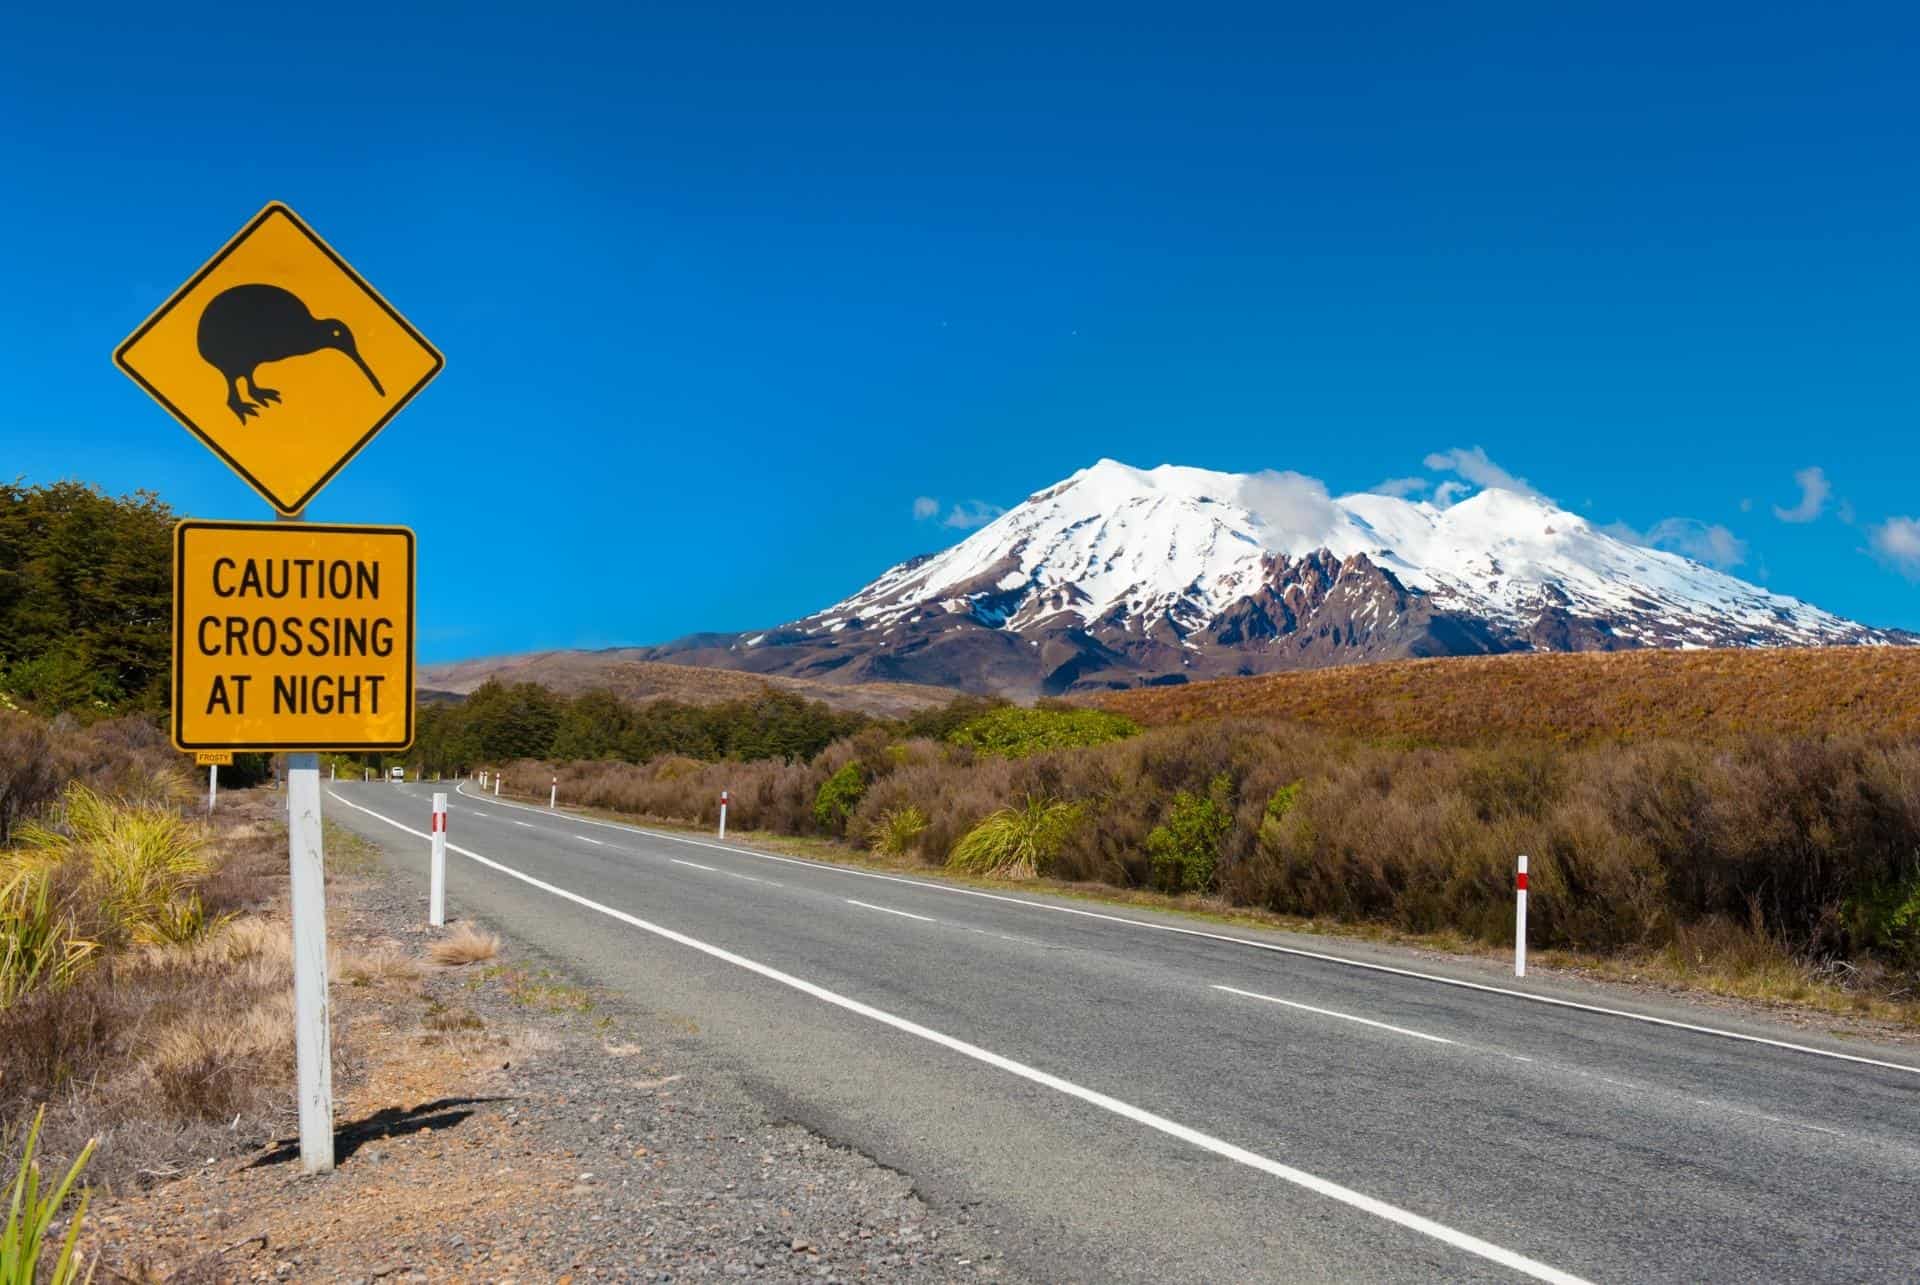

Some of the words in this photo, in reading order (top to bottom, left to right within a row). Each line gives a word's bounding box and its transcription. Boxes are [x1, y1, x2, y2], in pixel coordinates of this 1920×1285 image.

[212, 557, 379, 600] CAUTION
[198, 615, 393, 657] CROSSING
[206, 675, 252, 714] AT
[273, 675, 385, 714] NIGHT
